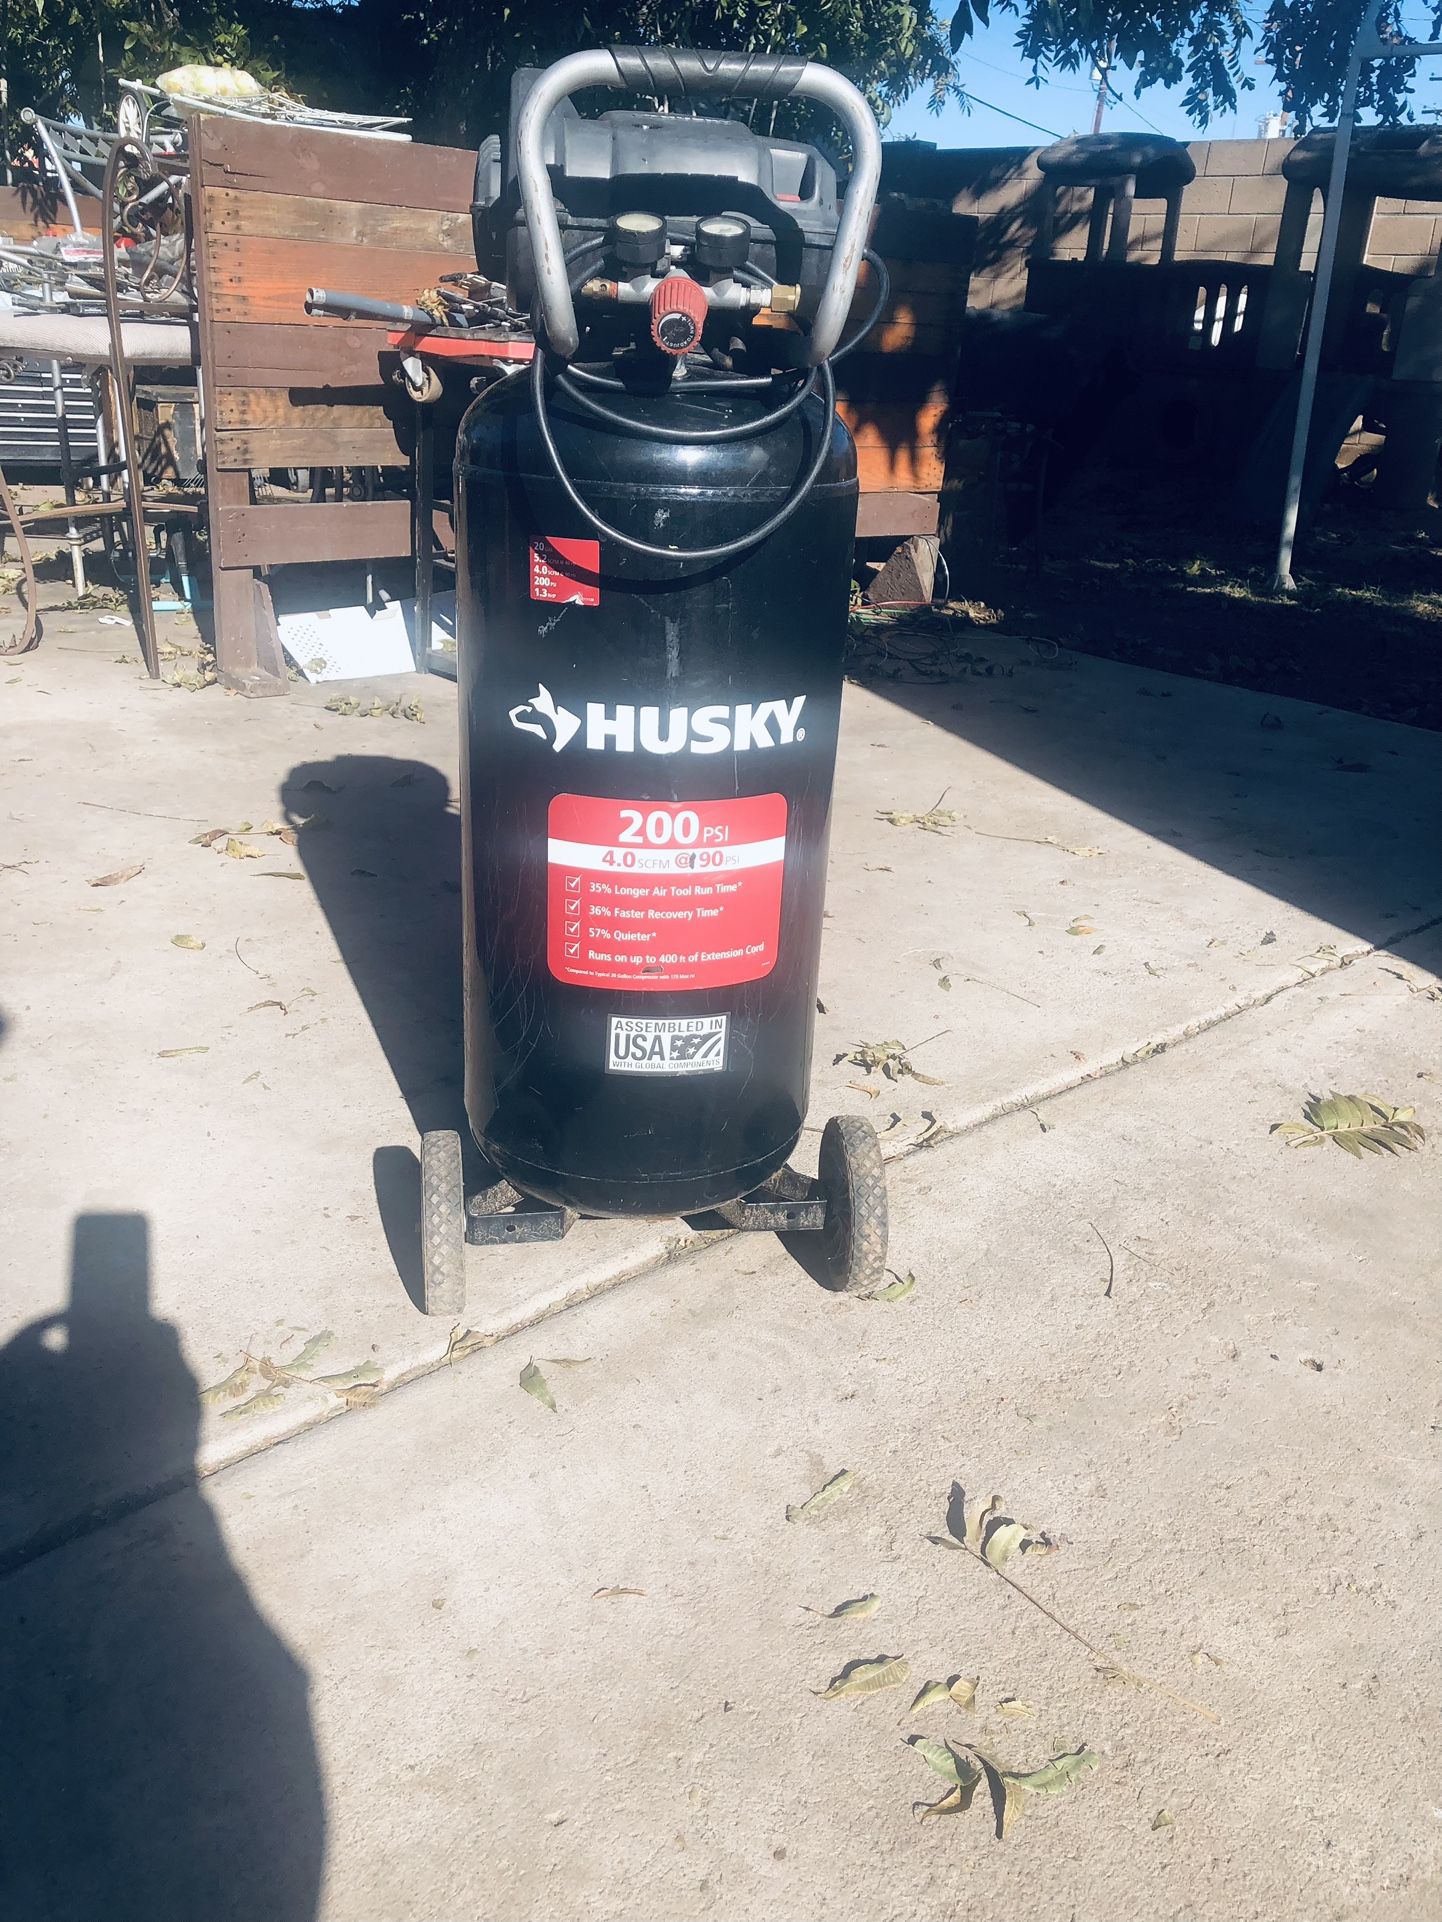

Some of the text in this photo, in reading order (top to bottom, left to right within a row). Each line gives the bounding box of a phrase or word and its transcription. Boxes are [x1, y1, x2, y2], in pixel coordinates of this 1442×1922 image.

[533, 542, 545, 551] 20
[533, 553, 547, 563] 5.2
[533, 565, 548, 575] 4.0
[534, 576, 551, 587] 200
[534, 587, 548, 597] 1.3
[618, 809, 729, 845] 200 PSI
[601, 850, 740, 869] 4.0 SCFM @ 90 PSI
[589, 881, 612, 894] 35%
[614, 885, 650, 898] Longer
[652, 886, 668, 897] Air
[670, 885, 692, 897] Tool
[694, 883, 713, 895] Run
[589, 904, 612, 917] 36%
[614, 907, 645, 919] Faster
[647, 908, 694, 921] Recovery
[588, 927, 611, 940] 57%
[588, 941, 765, 965] Runs on up to 400 ft of Extension Cord
[614, 1018, 723, 1033] ASSEMBLED IN
[614, 1032, 665, 1061] USA
[612, 1059, 720, 1070] WITH GLOBAL COMPONENTS
